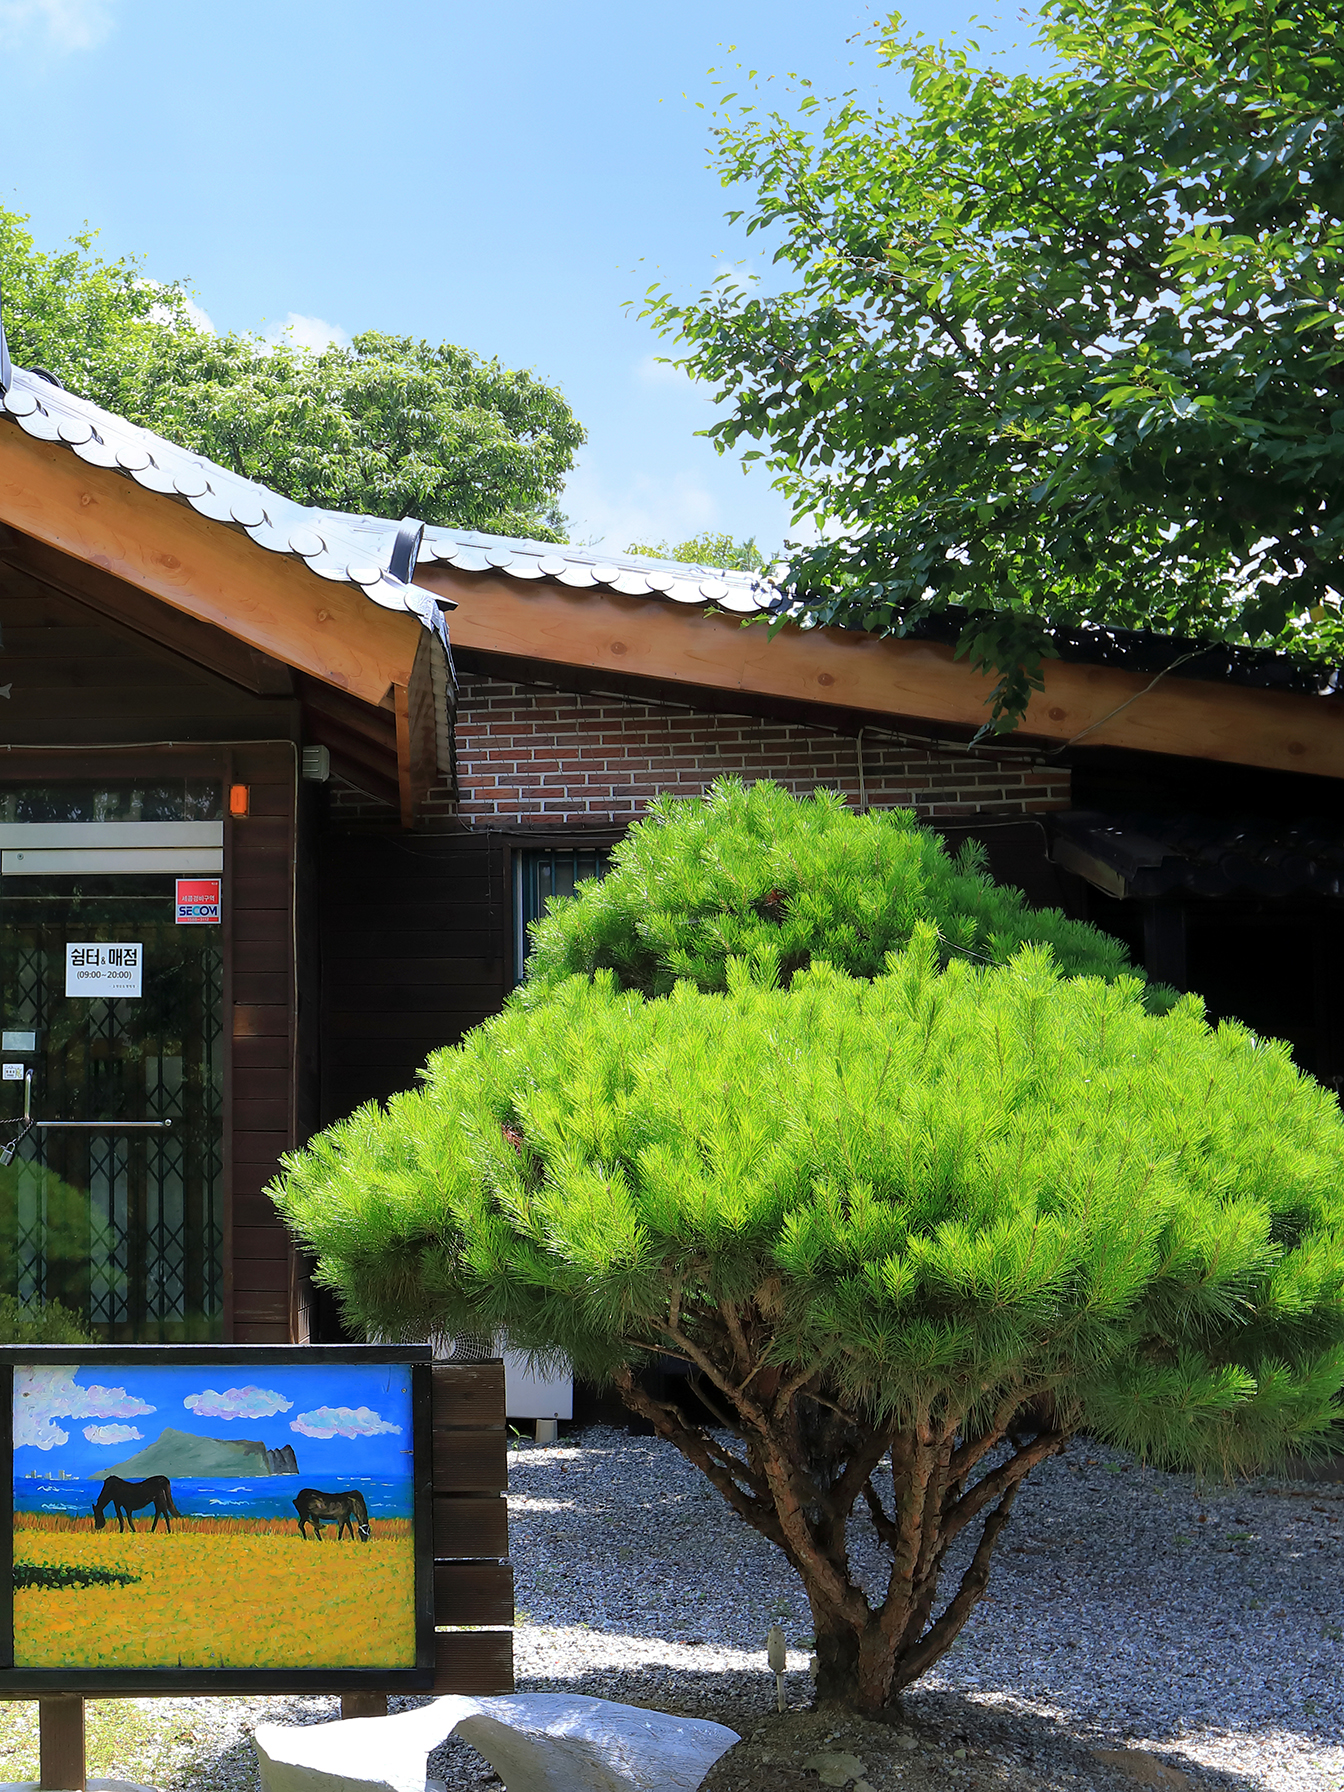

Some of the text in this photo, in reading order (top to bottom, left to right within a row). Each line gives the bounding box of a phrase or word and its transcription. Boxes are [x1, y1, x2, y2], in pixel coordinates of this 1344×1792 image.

[179, 905, 218, 917] SECOM
[109, 948, 137, 966] 매점
[77, 970, 132, 980] (09:00~20:00)
